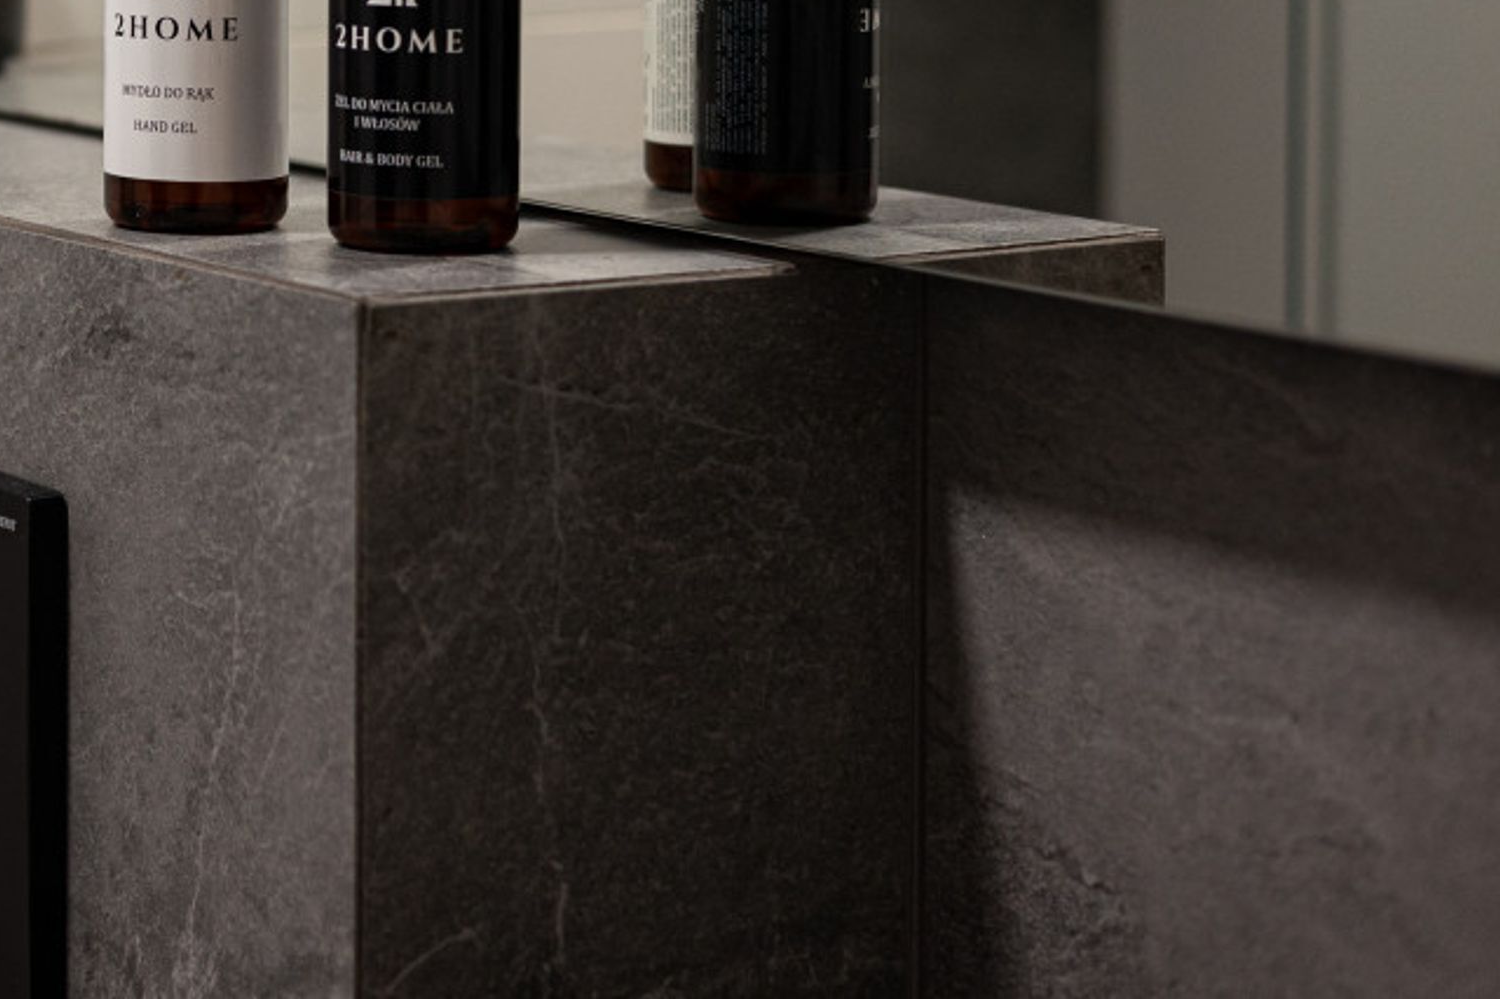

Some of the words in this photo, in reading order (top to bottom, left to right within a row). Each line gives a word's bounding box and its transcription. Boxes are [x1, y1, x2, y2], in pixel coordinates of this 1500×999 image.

[114, 12, 238, 41] 2HOME
[335, 23, 463, 53] 2HOME
[164, 86, 183, 98] DO
[369, 98, 410, 113] MYCIA
[412, 100, 454, 115] CIAŁA
[133, 119, 168, 133] HAND
[170, 121, 197, 134] GEL
[377, 152, 413, 167] BODY
[415, 154, 444, 168] GEL
